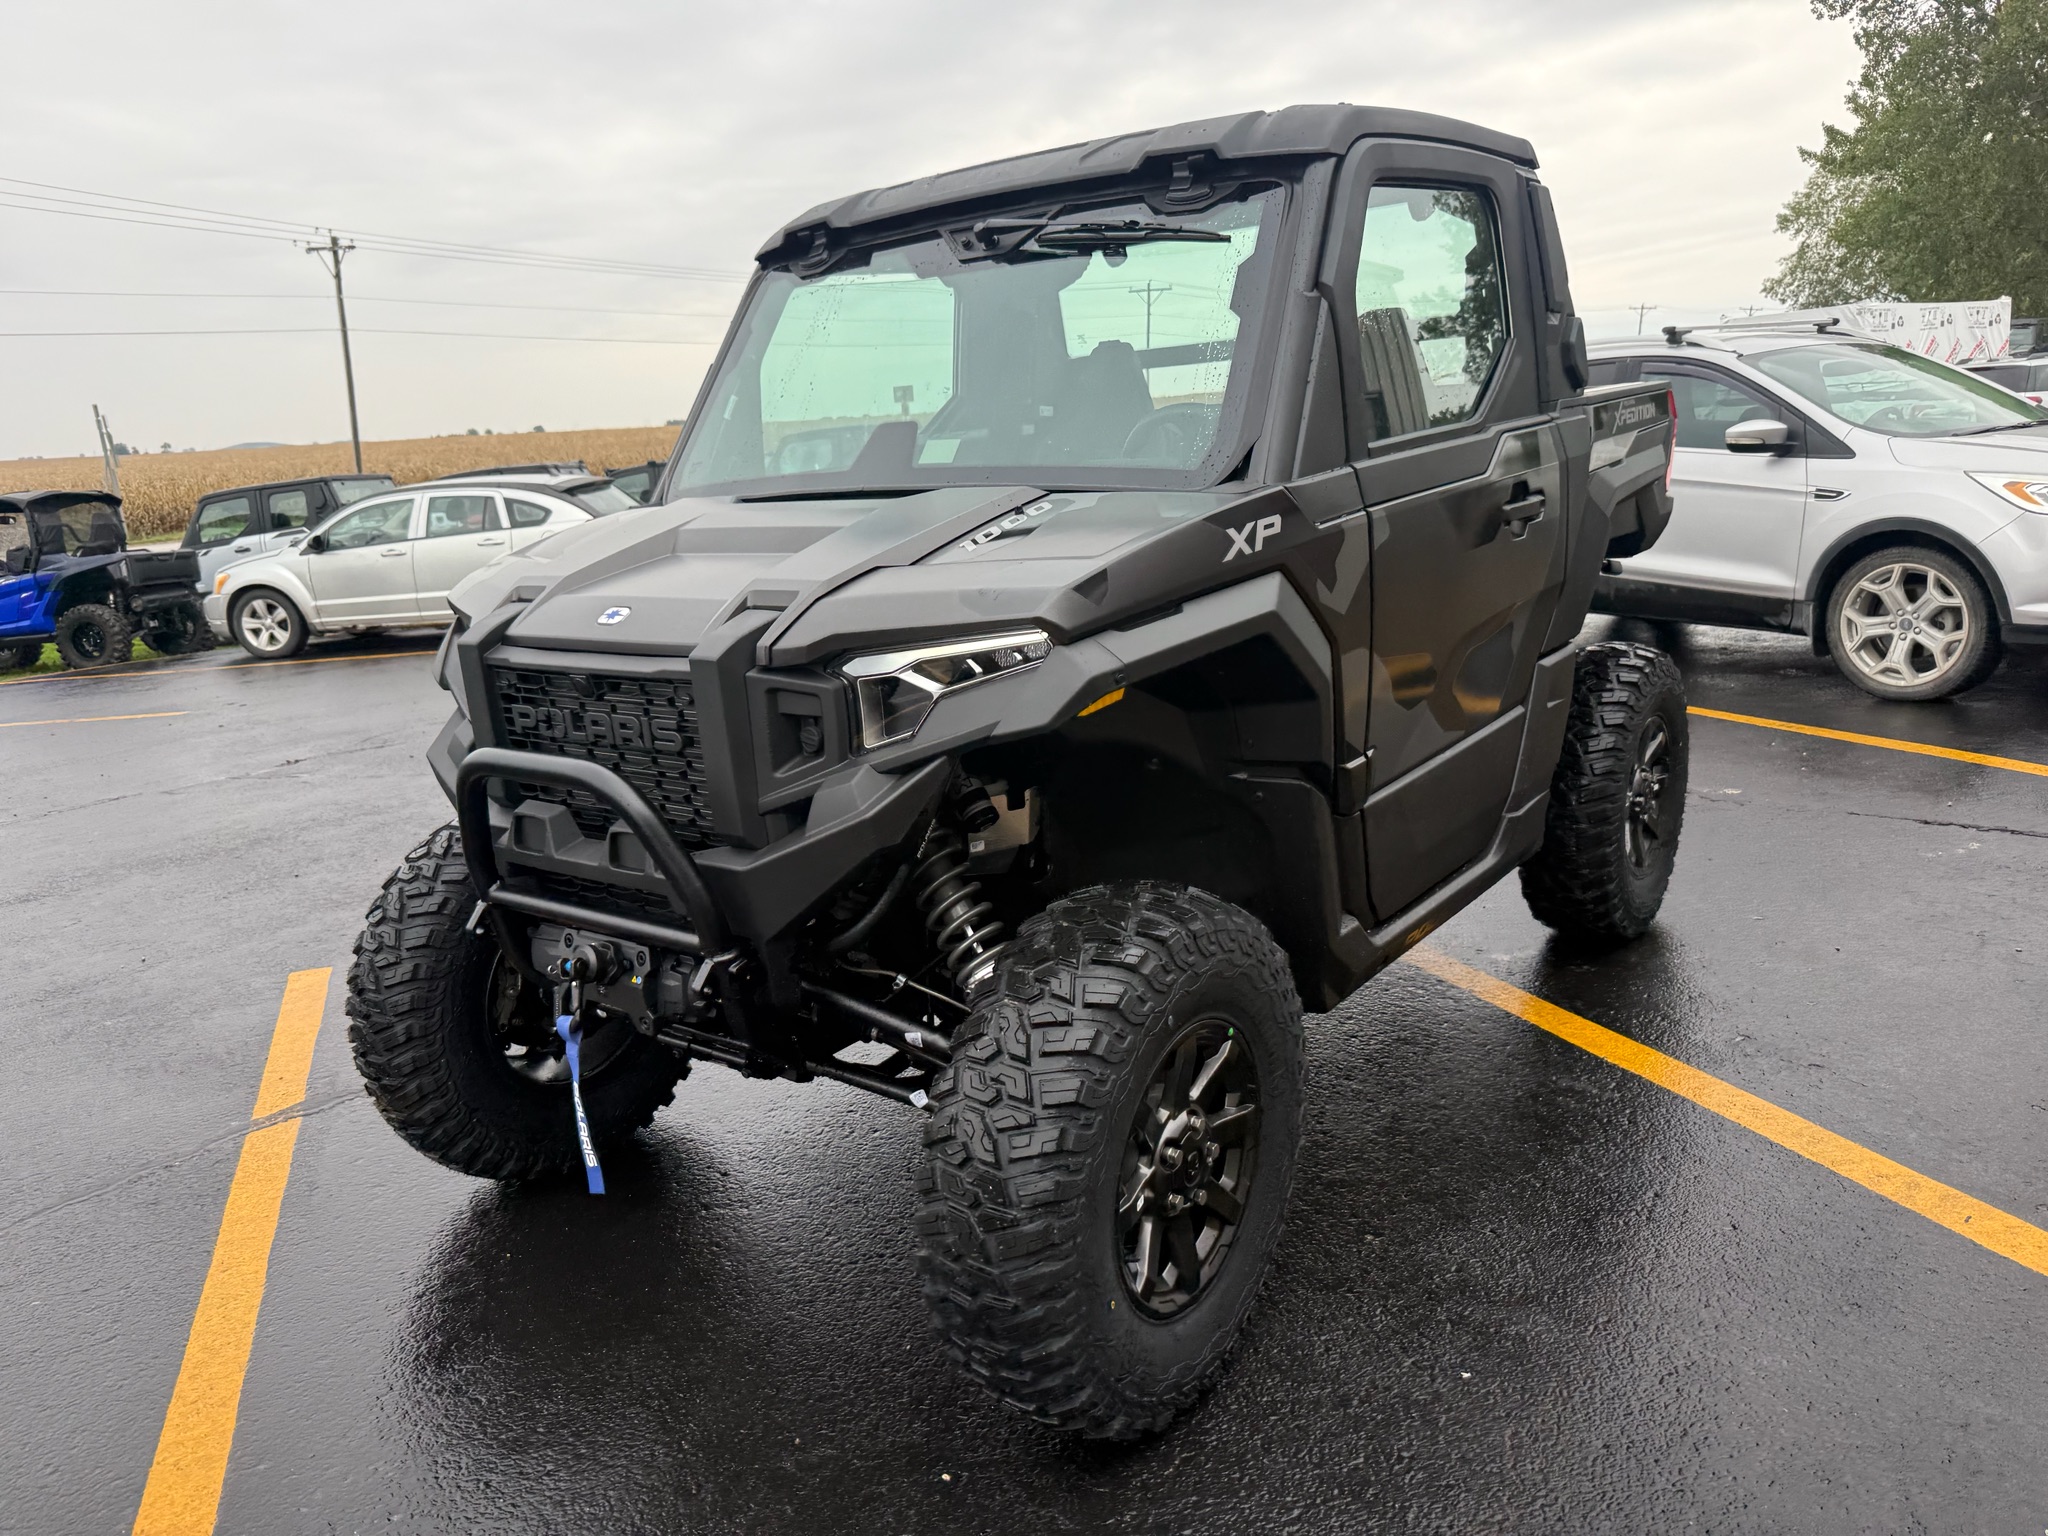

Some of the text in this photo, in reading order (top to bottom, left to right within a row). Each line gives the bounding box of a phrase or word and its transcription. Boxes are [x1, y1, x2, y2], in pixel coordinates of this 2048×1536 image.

[1612, 401, 1655, 434] XPEDITION
[959, 501, 1053, 552] 1000
[1222, 514, 1282, 563] XP
[511, 704, 683, 752] POLARIS
[572, 1080, 598, 1168] POLARIS
